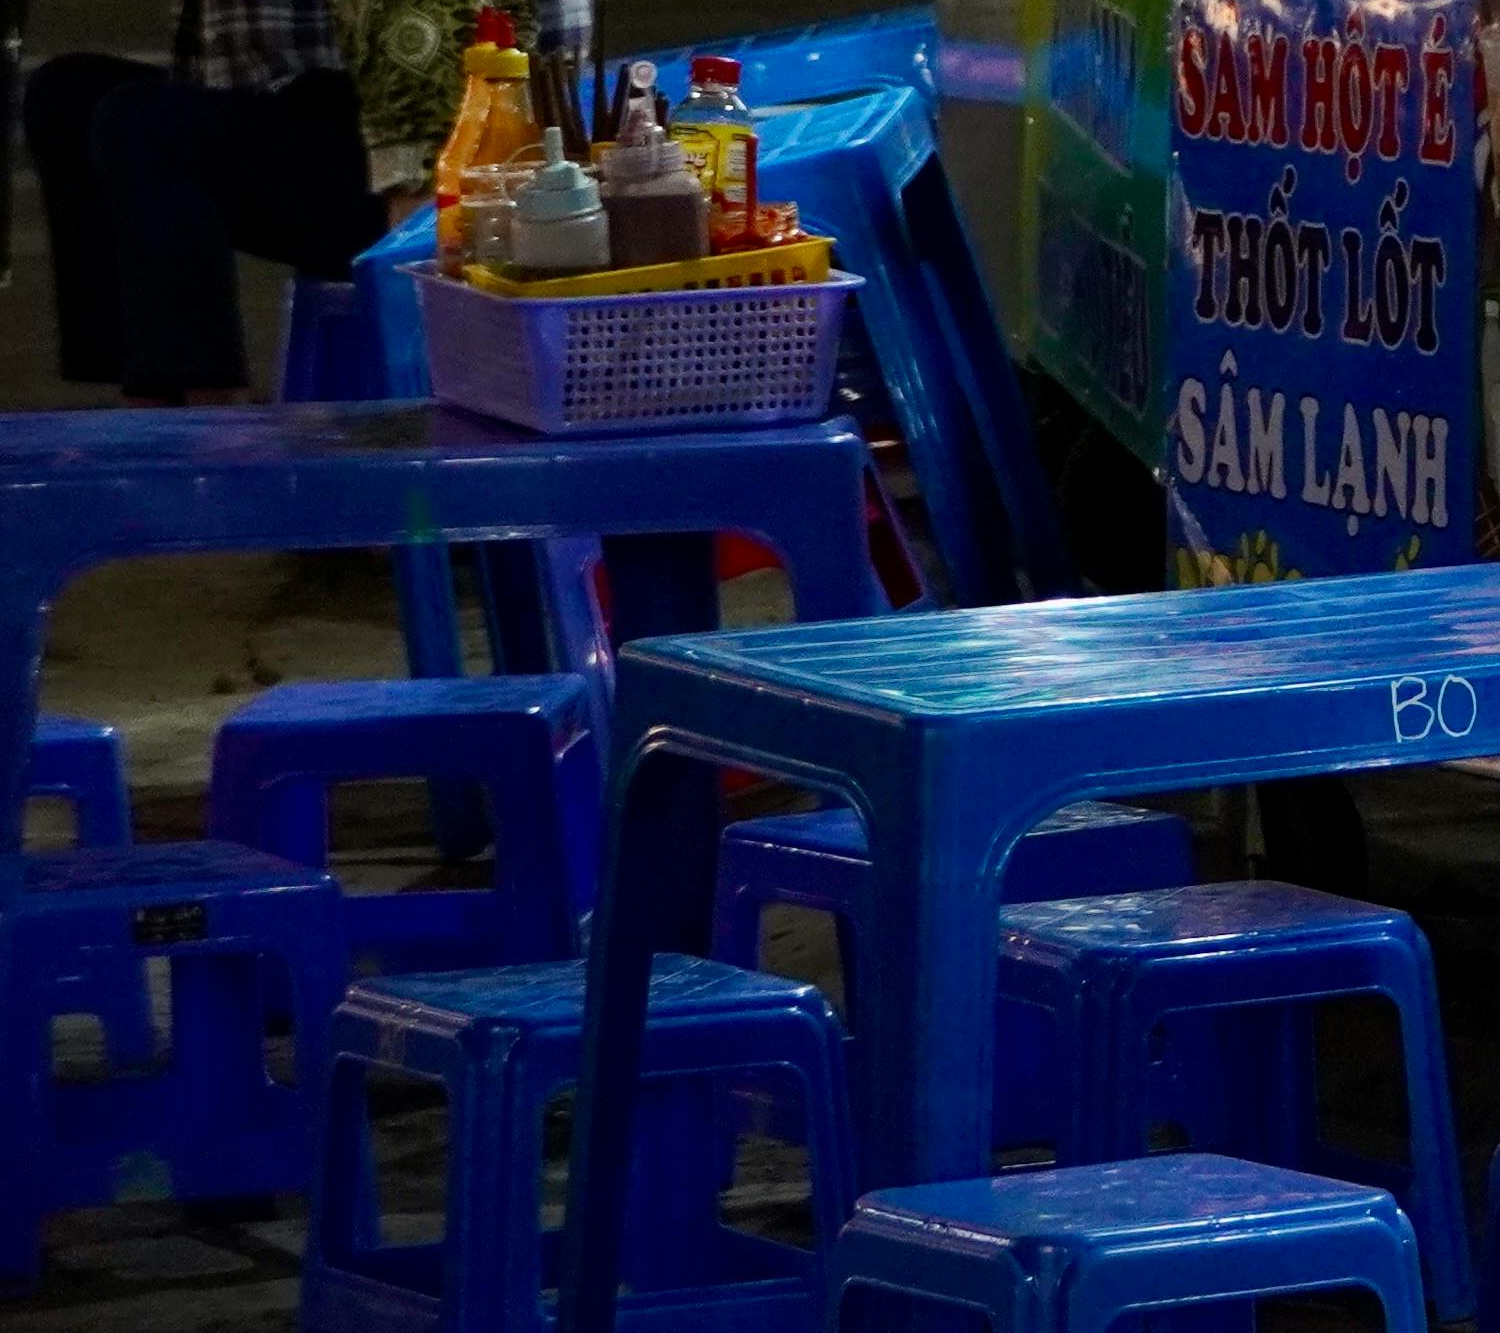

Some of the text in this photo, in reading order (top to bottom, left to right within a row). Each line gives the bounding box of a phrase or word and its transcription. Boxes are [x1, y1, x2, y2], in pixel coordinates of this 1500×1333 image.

[1303, 8, 1410, 185] HỘT
[1192, 165, 1331, 331] THỐT
[1340, 177, 1448, 356] LỐT
[1176, 349, 1449, 537] SÂM LẠNH
